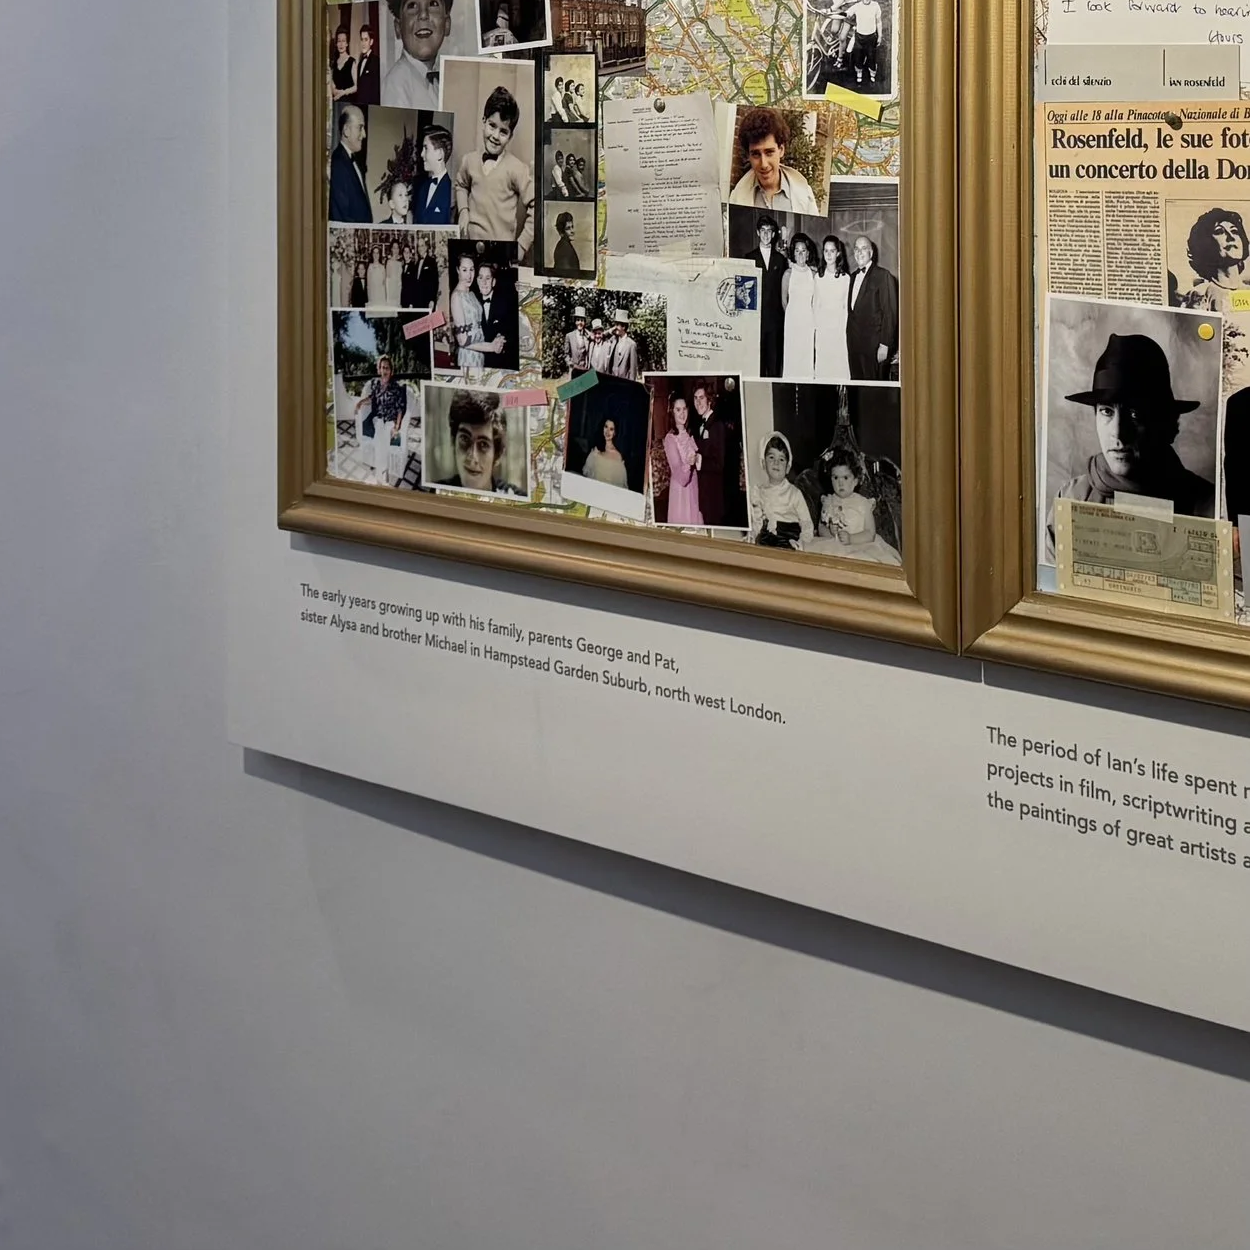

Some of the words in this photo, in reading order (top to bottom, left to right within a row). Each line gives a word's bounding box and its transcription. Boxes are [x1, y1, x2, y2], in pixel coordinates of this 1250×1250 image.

[1047, 110, 1067, 124] Oggi
[1070, 110, 1088, 121] alle
[1092, 110, 1101, 121] 18
[1104, 109, 1124, 121] alla
[1179, 108, 1227, 120] Nazionale
[1230, 107, 1240, 119] di
[1051, 128, 1149, 153] Rosenfeld,
[1157, 128, 1173, 149] le
[1181, 133, 1213, 149] sue
[1221, 126, 1250, 149] fot
[1049, 163, 1070, 179] un
[1076, 160, 1158, 180] concerto
[1163, 159, 1209, 180] della
[300, 583, 319, 598] The
[322, 590, 346, 607] early
[349, 596, 376, 610] years
[379, 602, 422, 622] growing
[426, 611, 439, 626] up
[443, 612, 466, 627] with
[470, 615, 485, 631] his
[488, 618, 524, 642] family,
[529, 631, 572, 649] parents
[577, 637, 623, 662] George
[627, 650, 650, 665] and
[655, 653, 679, 674] Pat,
[301, 609, 327, 625] sister
[330, 614, 357, 632] Alysa
[360, 622, 379, 635] and
[382, 623, 422, 644] brother
[425, 633, 467, 654] Michael
[471, 642, 480, 657] in
[484, 645, 550, 671] Hampstead
[554, 660, 598, 682] Garden
[603, 670, 650, 696] Suburb,
[656, 686, 690, 702] north
[694, 694, 725, 710] west
[730, 697, 785, 724] London.
[986, 726, 1017, 747] The
[1023, 739, 1077, 761] period
[1084, 749, 1101, 766] of
[1108, 752, 1145, 776] Ian's
[1152, 761, 1178, 783] life
[1185, 775, 1237, 796] spent
[987, 791, 1013, 811] the
[1020, 803, 1097, 834] paintings
[1103, 820, 1121, 837] of
[1127, 829, 1174, 850] great
[1180, 842, 1236, 864] artists
[988, 763, 1053, 788] projects
[1060, 775, 1073, 793] in
[1079, 779, 1116, 806] film,
[1123, 795, 1236, 835] scriptwriting
